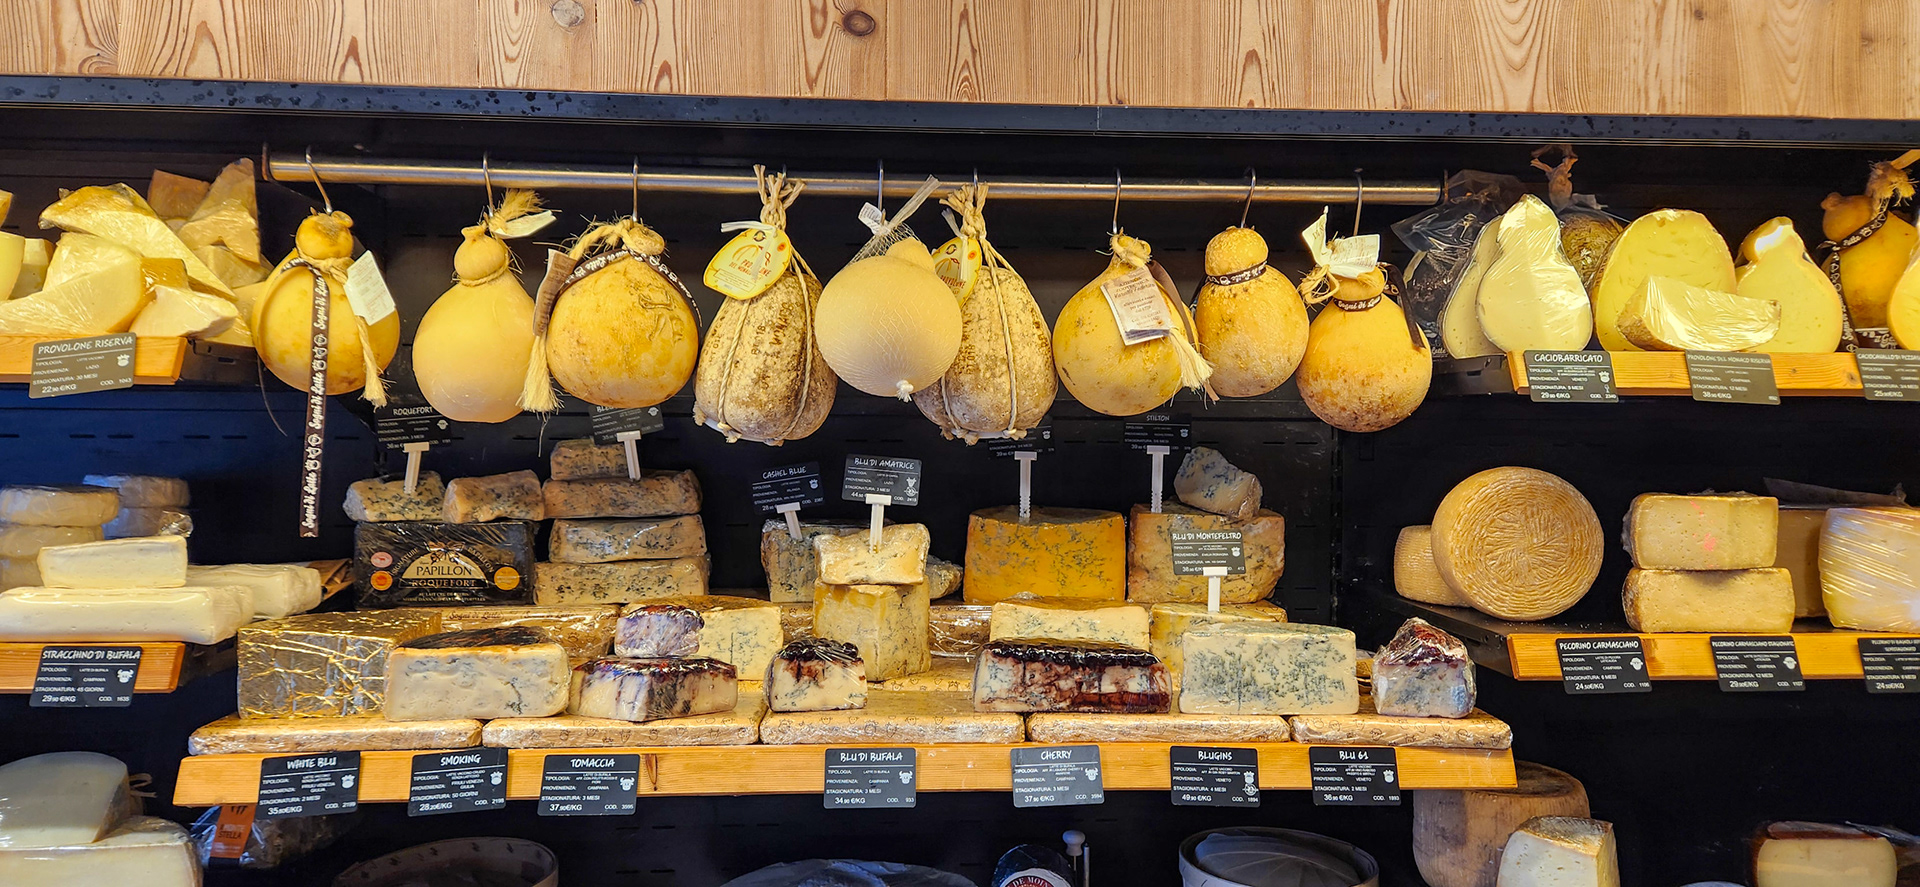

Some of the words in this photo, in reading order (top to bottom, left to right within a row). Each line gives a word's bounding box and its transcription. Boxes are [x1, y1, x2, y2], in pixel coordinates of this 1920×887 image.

[314, 306, 328, 330] Sogni
[38, 341, 92, 354] PROVOLONE
[95, 336, 134, 348] RISERVA
[1534, 354, 1602, 362] CACIOBARRICATO
[310, 372, 325, 395] Latte
[393, 406, 433, 416] ROQUEFORT
[309, 404, 324, 429] Sogni
[854, 458, 869, 466] BLU
[879, 460, 914, 470] AMATRICE
[763, 470, 788, 479] CASHEL
[788, 466, 806, 476] BLUE
[304, 472, 318, 495] Latte
[302, 504, 316, 528] Sogni
[416, 566, 472, 576] PAPILLON
[412, 579, 477, 588] ROQUEFORT
[1560, 641, 1591, 650] PECORINO
[1592, 640, 1638, 649] CARMASCIANO
[42, 650, 94, 660] STRACCHINO
[94, 650, 104, 659] DI
[106, 650, 140, 660] BUFALA
[440, 754, 481, 766] SMOKING
[840, 752, 857, 762] BLU
[858, 752, 868, 762] DI
[870, 752, 903, 762] BUFALA
[1040, 750, 1072, 760] CHERRY
[1198, 750, 1232, 760] BLUGINS
[1339, 750, 1356, 760] BLU
[1358, 751, 1369, 760] 61
[286, 758, 316, 770] WHITE
[317, 757, 337, 768] BLU
[570, 758, 616, 768] TOMACCIA
[218, 830, 242, 839] STELLA
